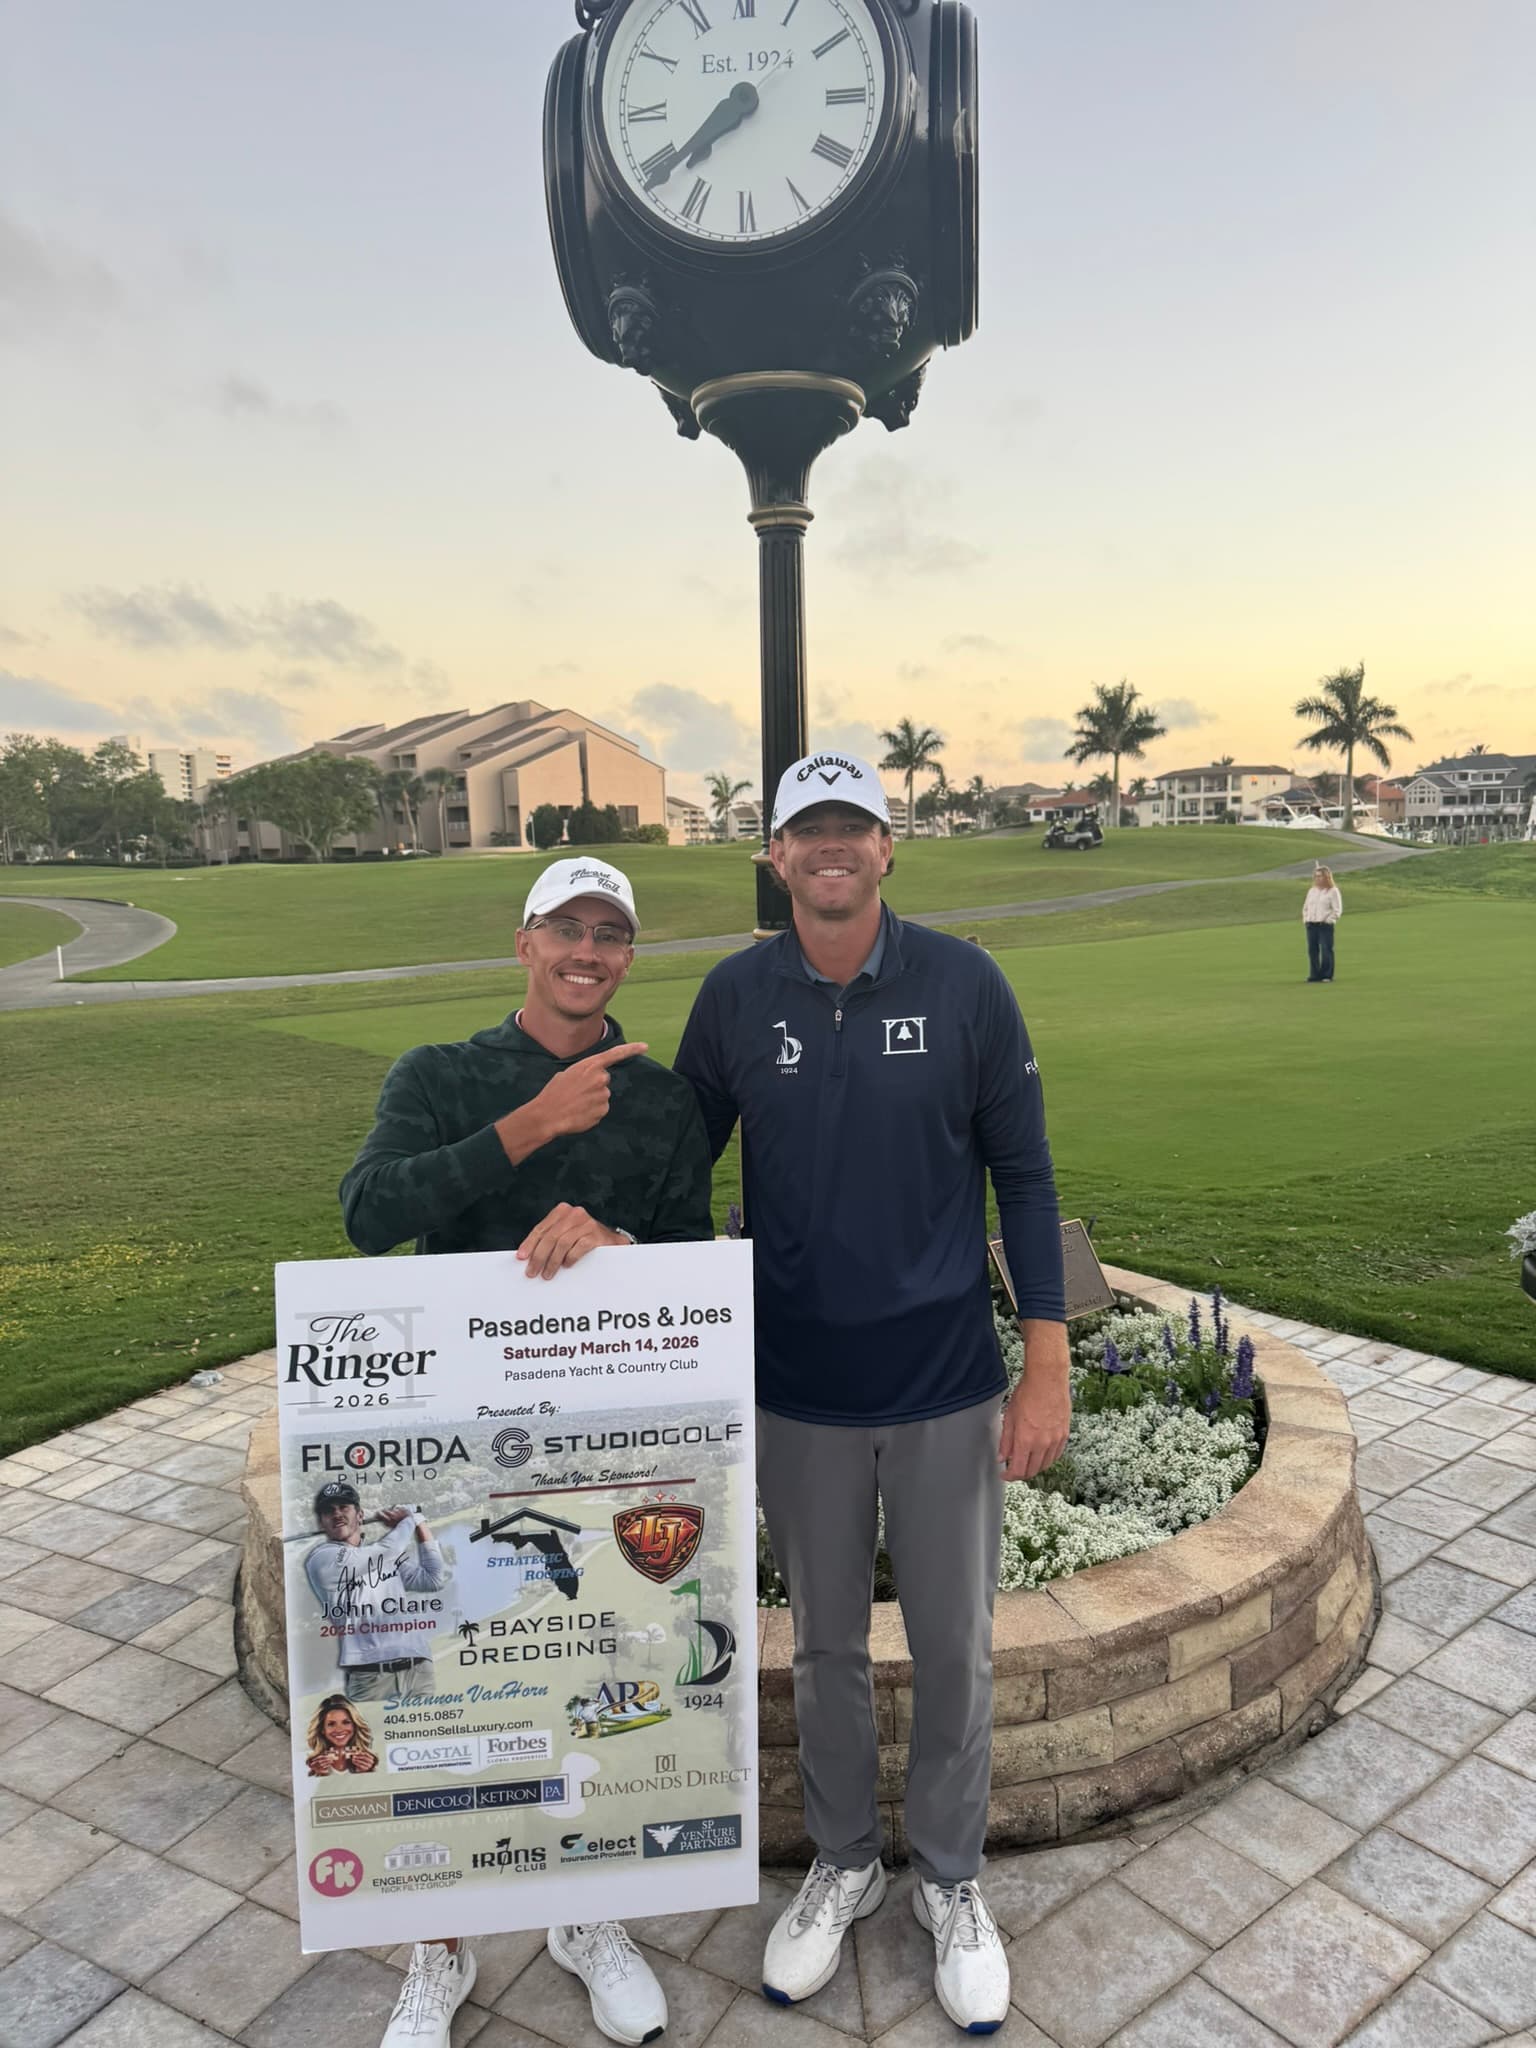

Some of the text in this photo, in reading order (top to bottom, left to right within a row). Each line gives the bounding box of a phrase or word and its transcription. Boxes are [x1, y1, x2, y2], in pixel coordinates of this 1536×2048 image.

[811, 27, 851, 60] II
[701, 49, 795, 73] Est. 1924
[796, 755, 864, 781] Callaway
[780, 1067, 798, 1075] 1924
[310, 1312, 380, 1346] The
[468, 1304, 733, 1338] Pasadena Pros & Joes
[503, 1335, 700, 1360] Saturday March 14, 2026
[283, 1343, 438, 1388] Ringer
[504, 1358, 699, 1382] Pasadena Yacht & Country Club
[333, 1393, 390, 1409] 2026
[476, 1401, 561, 1420] Presented By:
[301, 1434, 471, 1473] FLORIDA
[337, 1468, 438, 1485] PHYSIO
[531, 1464, 658, 1488] Thank You Sponsors!
[487, 1552, 564, 1569] STRATEGIC
[525, 1567, 584, 1581] ROOFING
[321, 1597, 442, 1619] John Clare
[320, 1618, 437, 1638] 2025 Champion
[490, 1611, 616, 1637] BAYSIDE
[460, 1638, 617, 1666] DREDGING
[384, 1689, 464, 1711] Shannon
[684, 1692, 724, 1711] 1924
[384, 1709, 464, 1725] 404.915.0857
[384, 1719, 533, 1741] ShannonSellsLuxury.com
[389, 1745, 473, 1767] COASTAL
[487, 1736, 548, 1754] Forbes
[580, 1768, 752, 1799] DIAMONDS DIRECT
[318, 1801, 388, 1819] GASSMAN
[396, 1792, 471, 1813] DENICOLO
[480, 1787, 537, 1805] KETRON
[681, 1827, 735, 1841] VENTURE
[702, 1820, 715, 1830] SP
[680, 1836, 737, 1852] PARTNERS
[515, 1862, 547, 1873] CLUB
[560, 1849, 637, 1864] Insurance Providers
